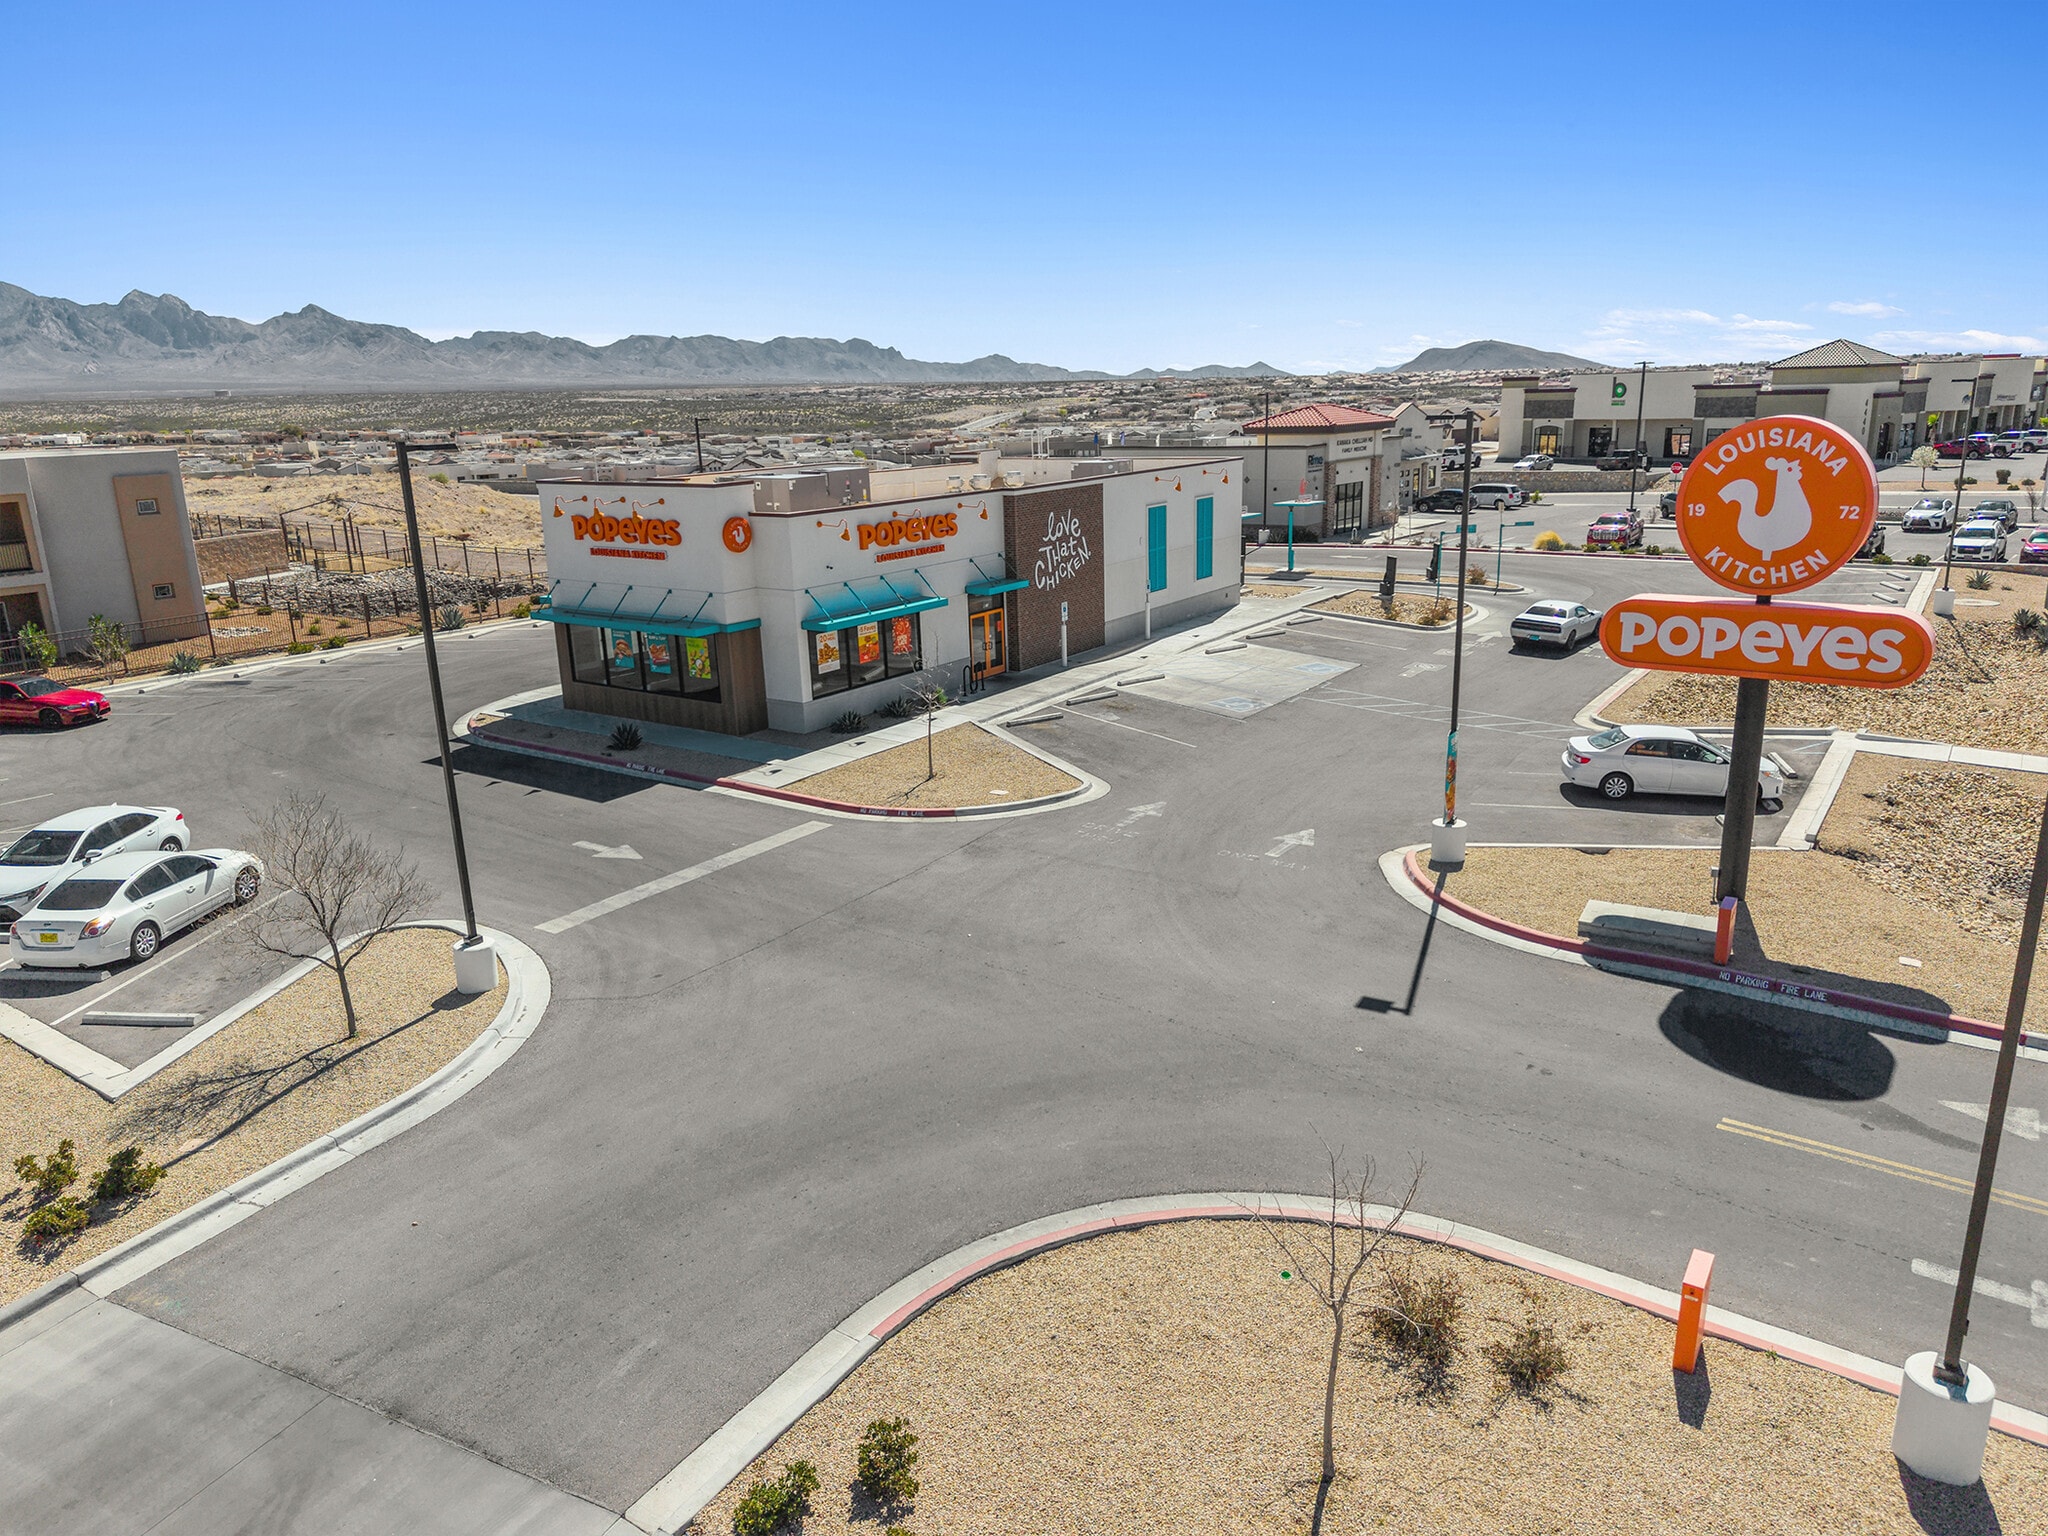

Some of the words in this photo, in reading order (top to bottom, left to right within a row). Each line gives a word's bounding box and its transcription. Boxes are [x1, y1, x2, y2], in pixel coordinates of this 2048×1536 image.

[1703, 427, 1849, 477] LOUISIANA
[1687, 503, 1706, 517] 19
[1839, 505, 1861, 520] 72
[590, 547, 631, 558] LOUISIANA
[631, 550, 666, 560] KITCHEN
[876, 549, 915, 563] LOUISIANA
[915, 544, 945, 556] KITCHEN
[1704, 545, 1830, 585] KITCHEN
[1719, 971, 1731, 981] NO
[1735, 974, 1769, 989] PARKING
[1780, 983, 1801, 995] FIRE
[1804, 989, 1828, 1001] LANE
